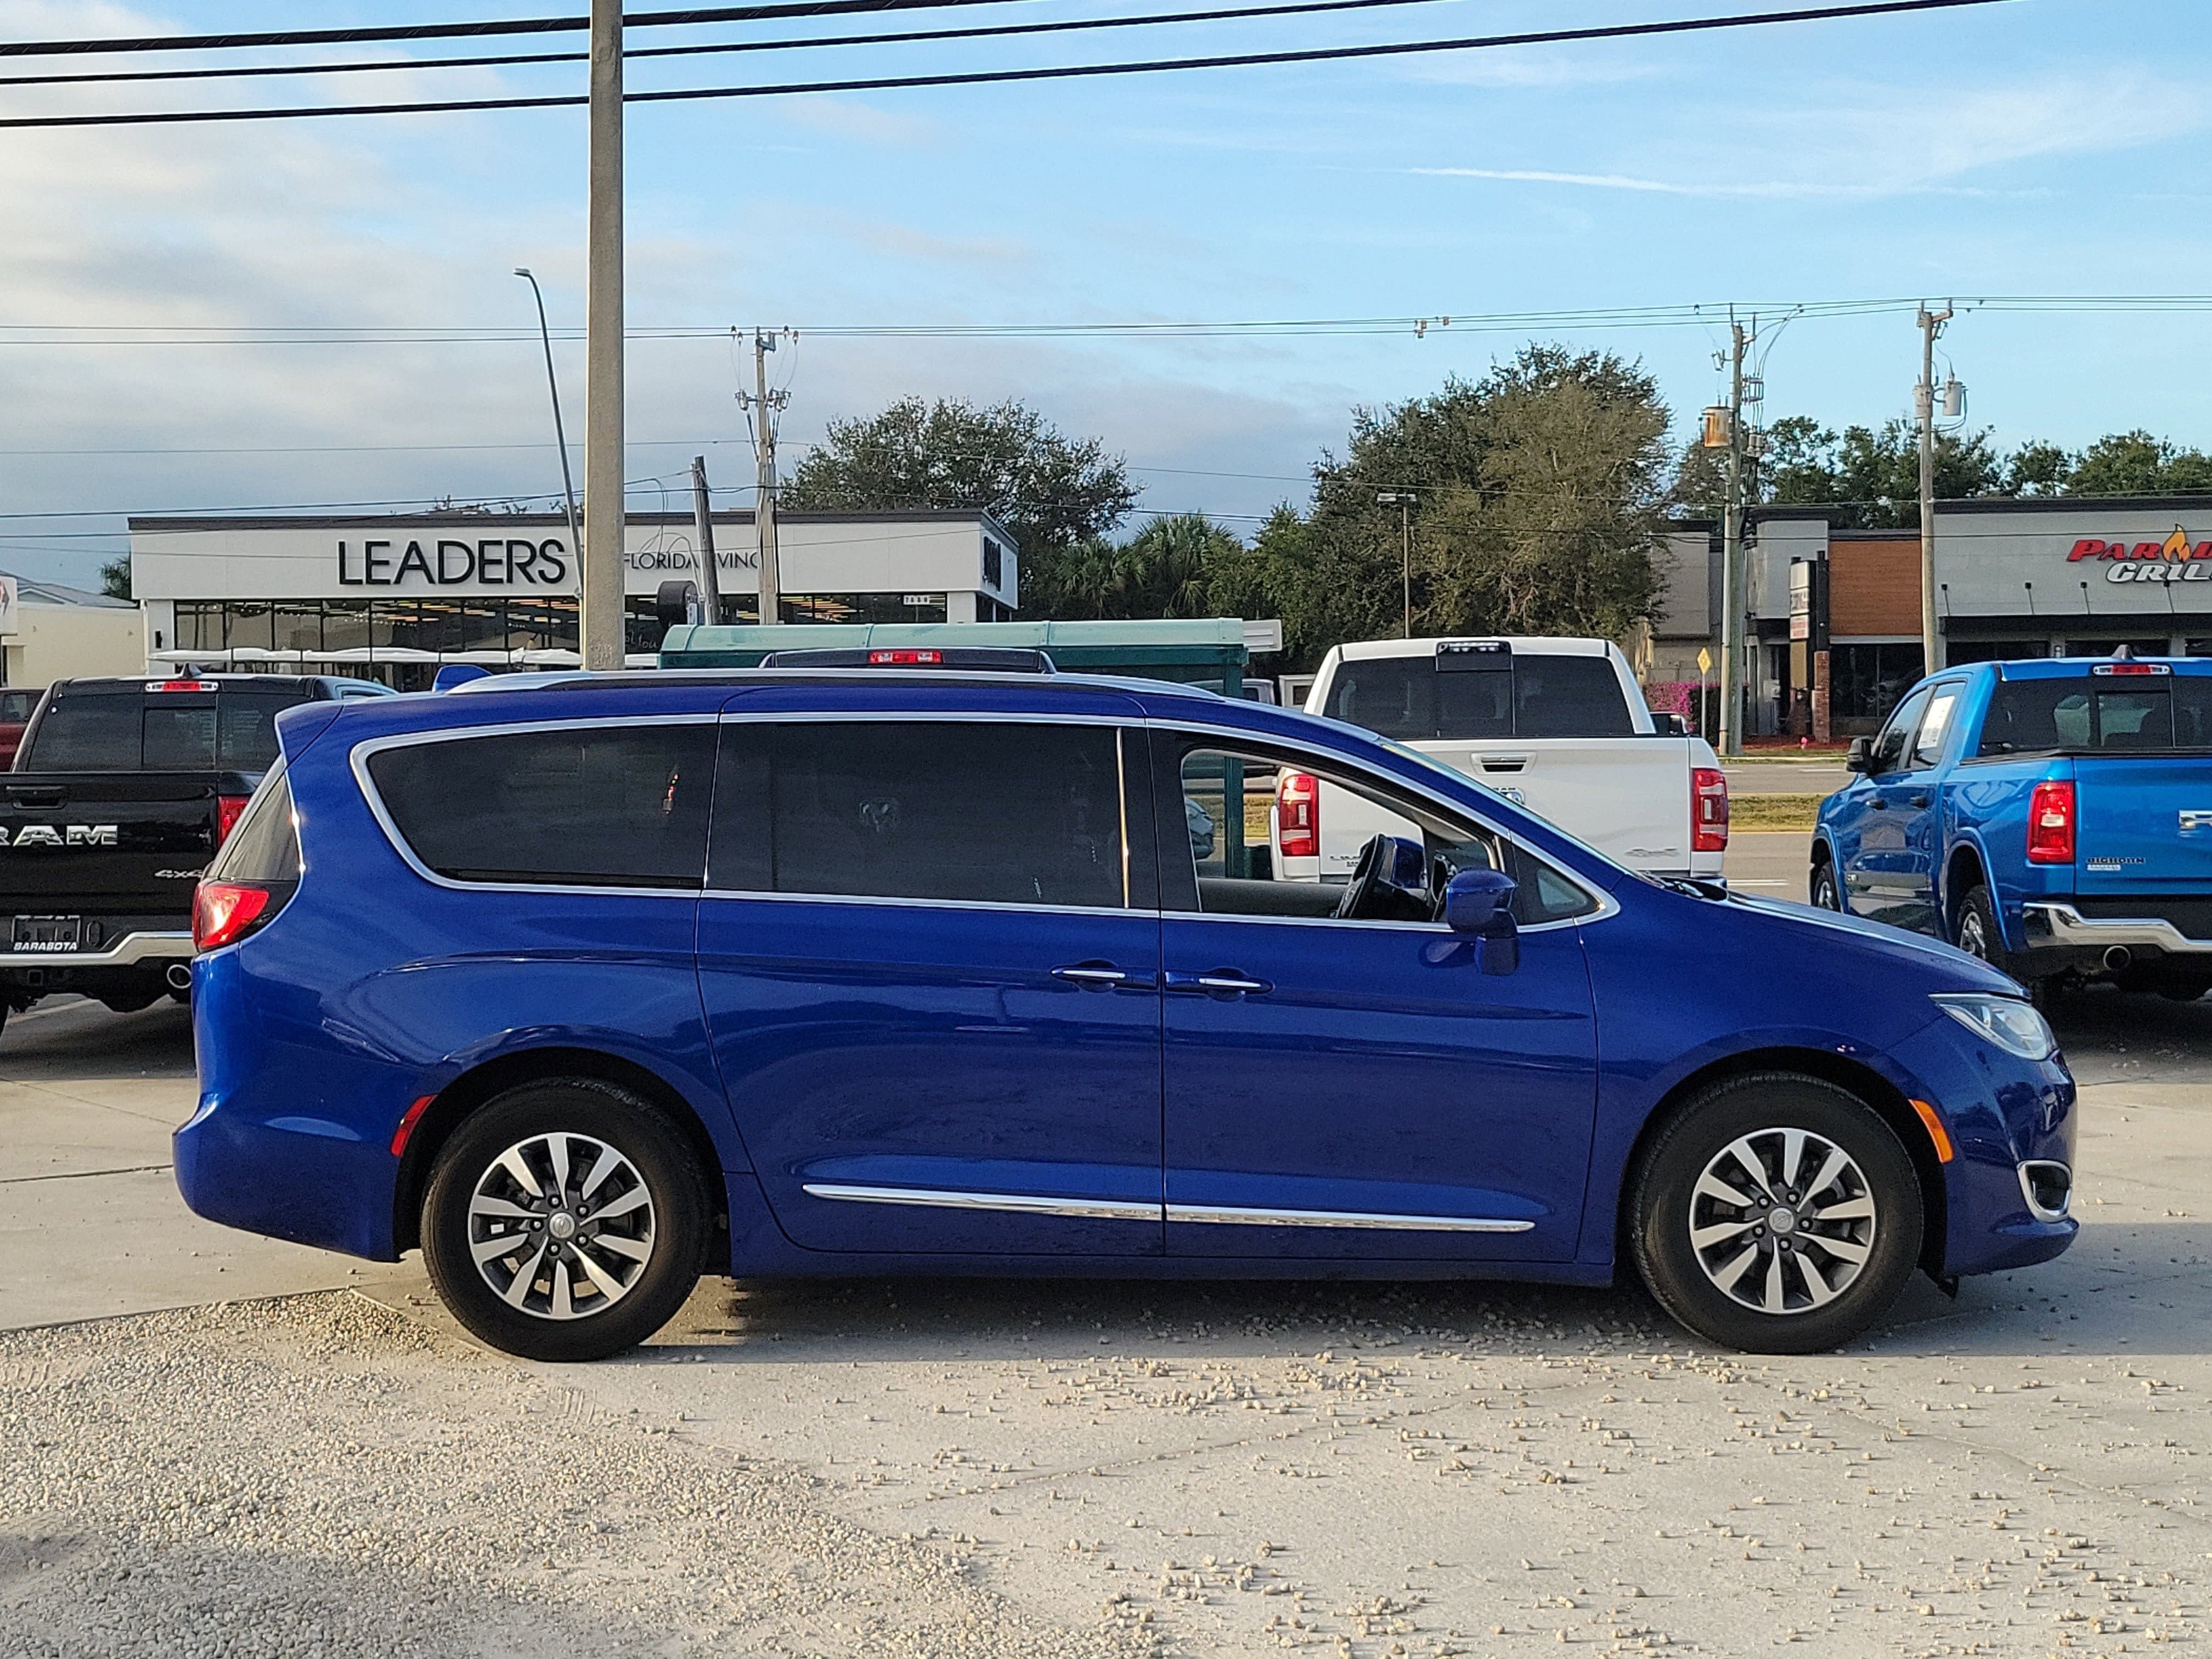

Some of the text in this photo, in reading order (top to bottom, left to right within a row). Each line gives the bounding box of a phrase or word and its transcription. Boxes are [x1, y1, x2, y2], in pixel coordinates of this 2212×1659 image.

[338, 539, 566, 585] LEADERS
[2106, 561, 2212, 583] GRIL
[0, 825, 118, 847] AM
